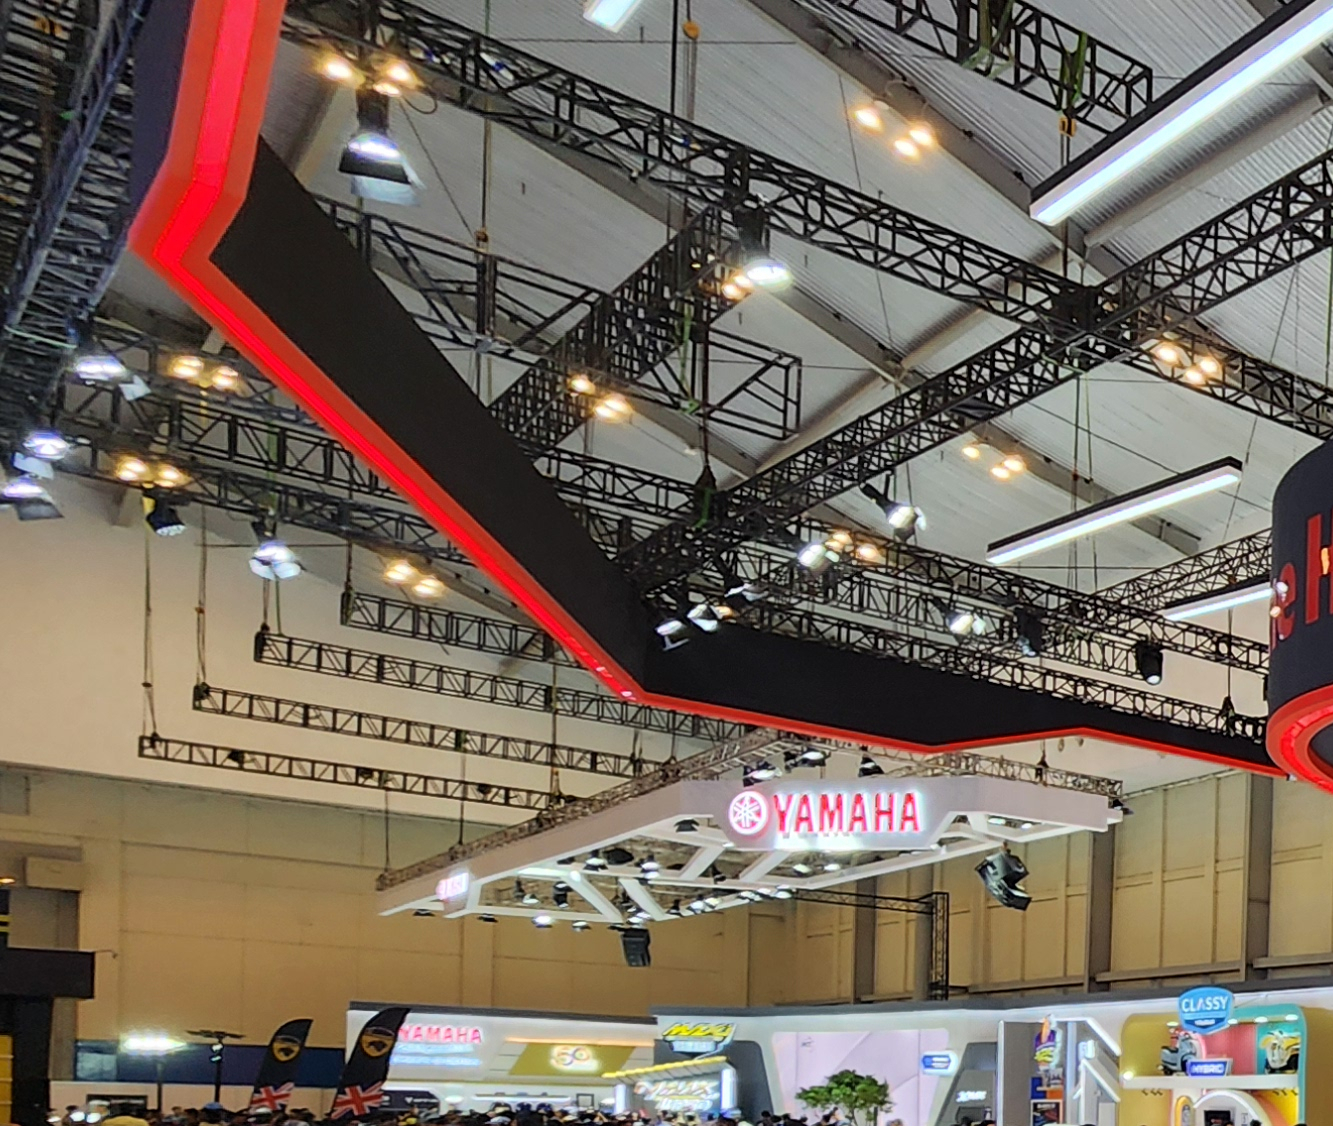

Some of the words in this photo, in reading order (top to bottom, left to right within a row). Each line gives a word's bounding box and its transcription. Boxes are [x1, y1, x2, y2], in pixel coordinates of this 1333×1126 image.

[773, 792, 921, 834] YAMAHA
[1181, 996, 1228, 1012] CLASSY
[399, 1025, 482, 1044] YAMAHA
